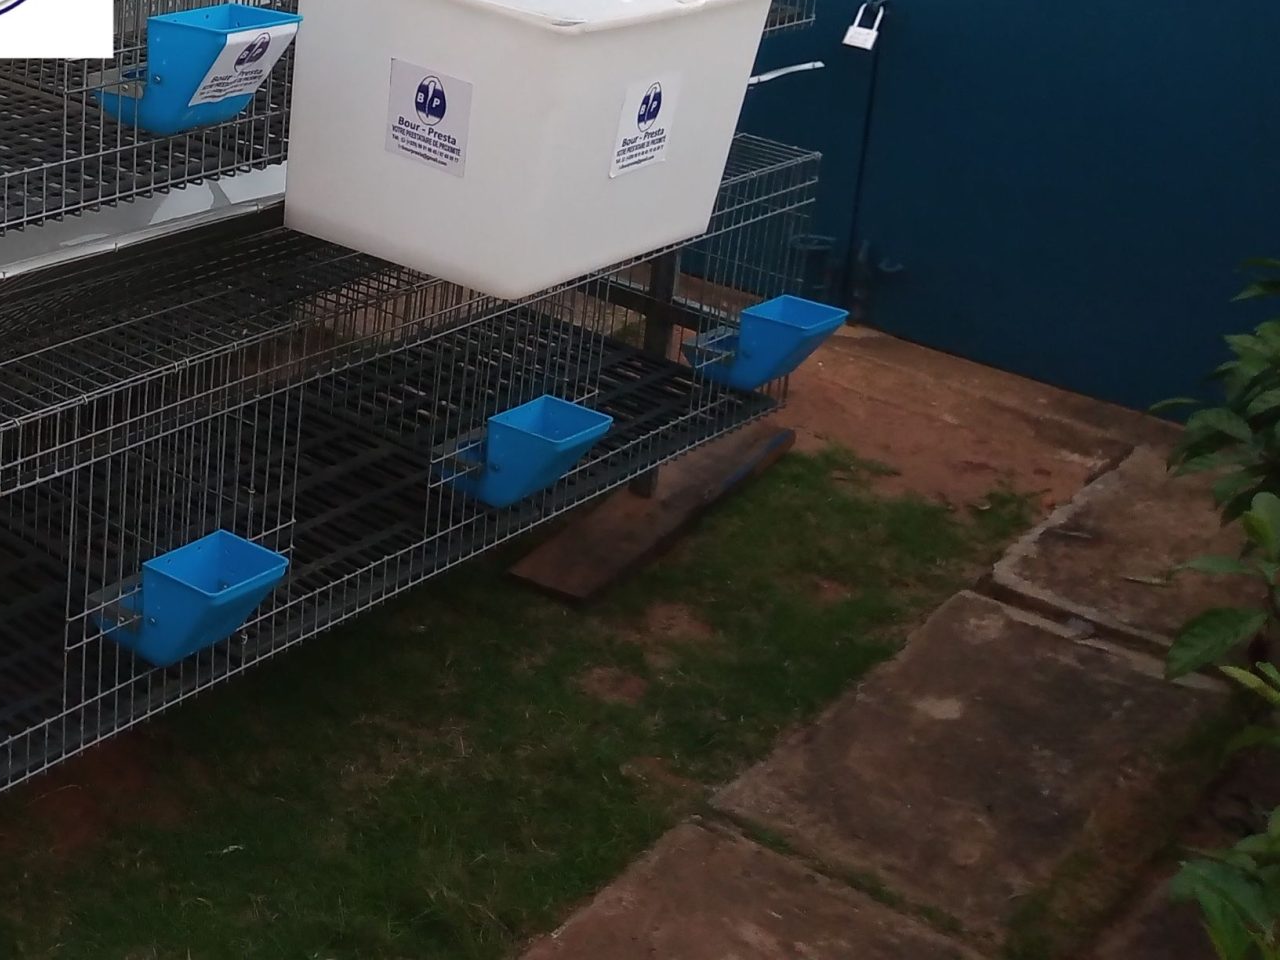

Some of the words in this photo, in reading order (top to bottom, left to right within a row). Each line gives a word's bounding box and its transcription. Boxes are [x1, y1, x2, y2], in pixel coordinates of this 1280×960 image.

[417, 92, 425, 103] B
[432, 98, 440, 108] P
[650, 101, 658, 112] P
[398, 115, 420, 131] Bour
[427, 127, 457, 145] Presta
[622, 136, 639, 147] Bour
[643, 128, 664, 140] Presta
